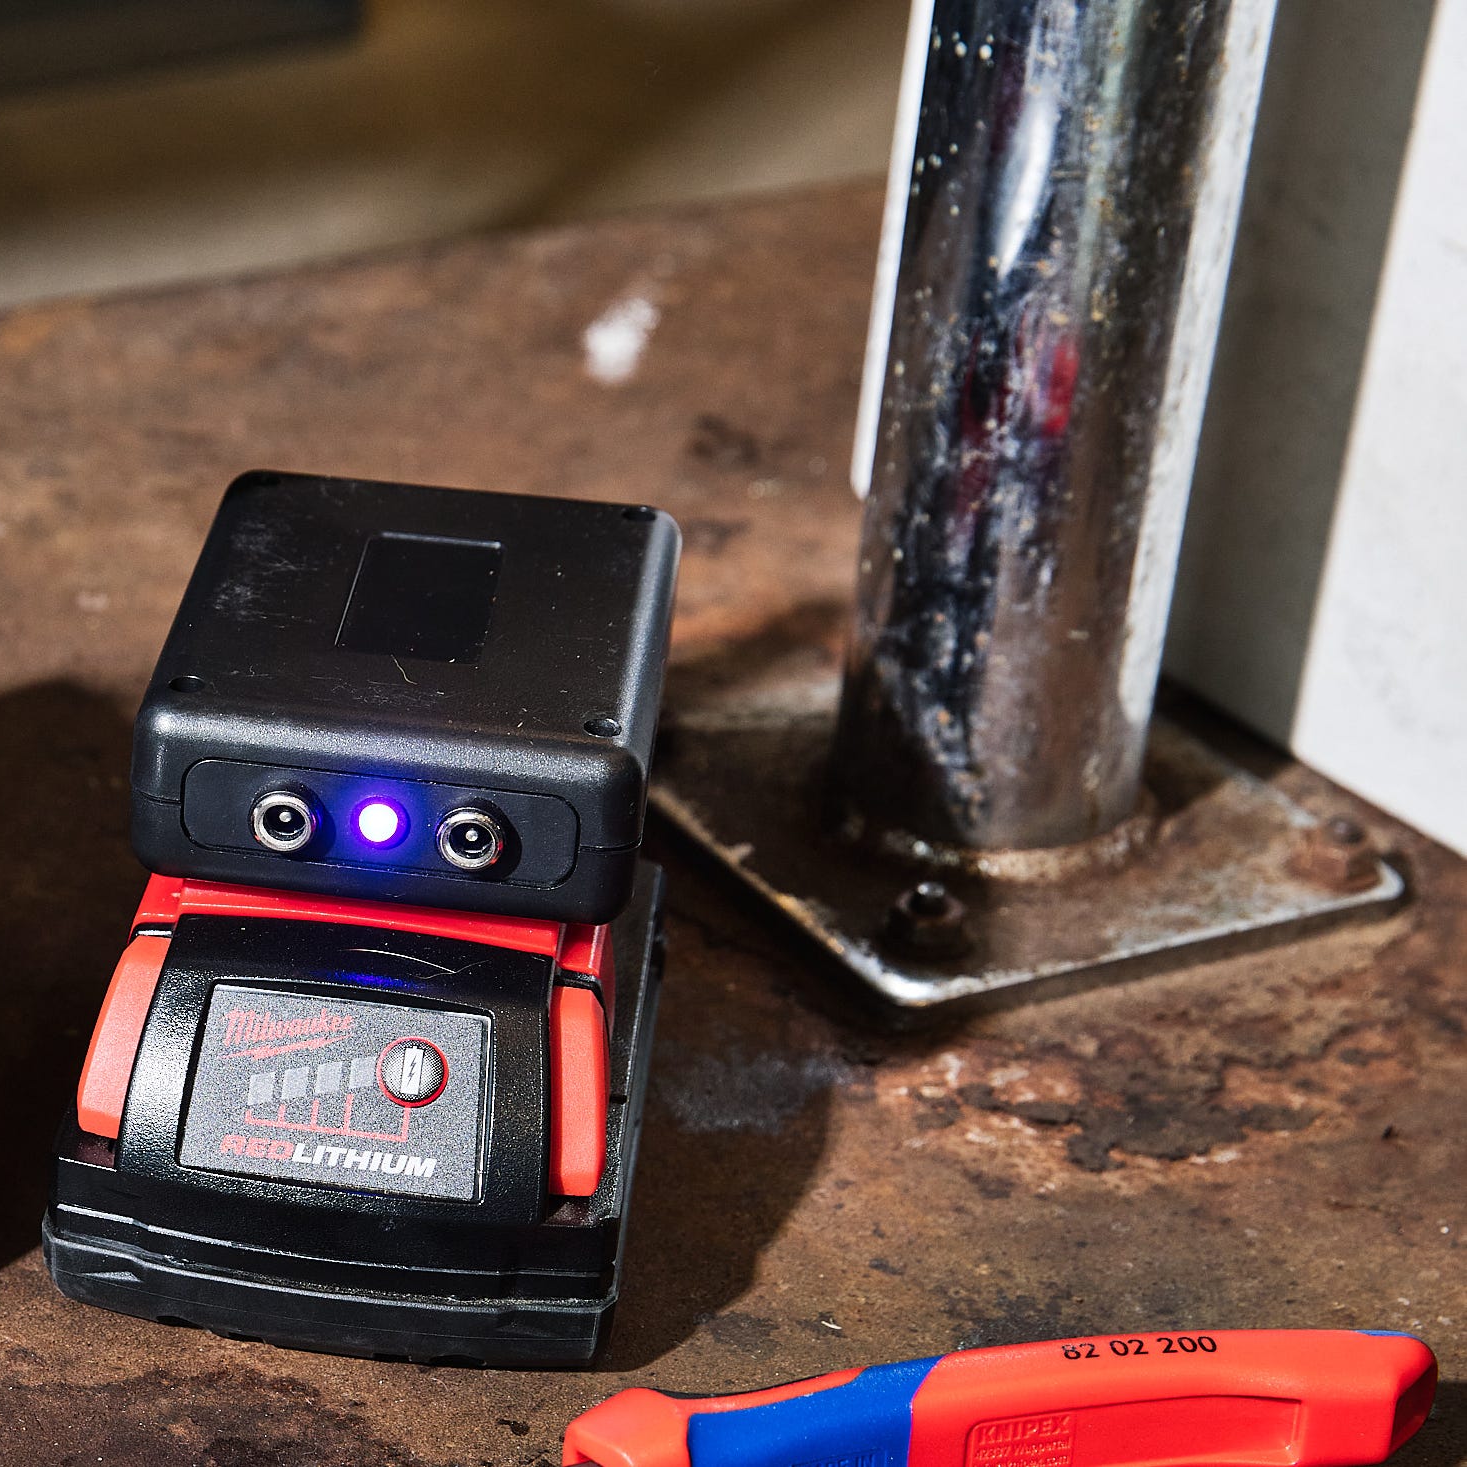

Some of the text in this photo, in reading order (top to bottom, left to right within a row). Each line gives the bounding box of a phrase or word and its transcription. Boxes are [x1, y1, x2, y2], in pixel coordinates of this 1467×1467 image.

[221, 1007, 355, 1047] Milwaukee
[219, 1133, 437, 1179] REDLITHIUM
[1061, 1336, 1218, 1360] 82 02 200
[979, 1416, 1071, 1446] KNIPEX
